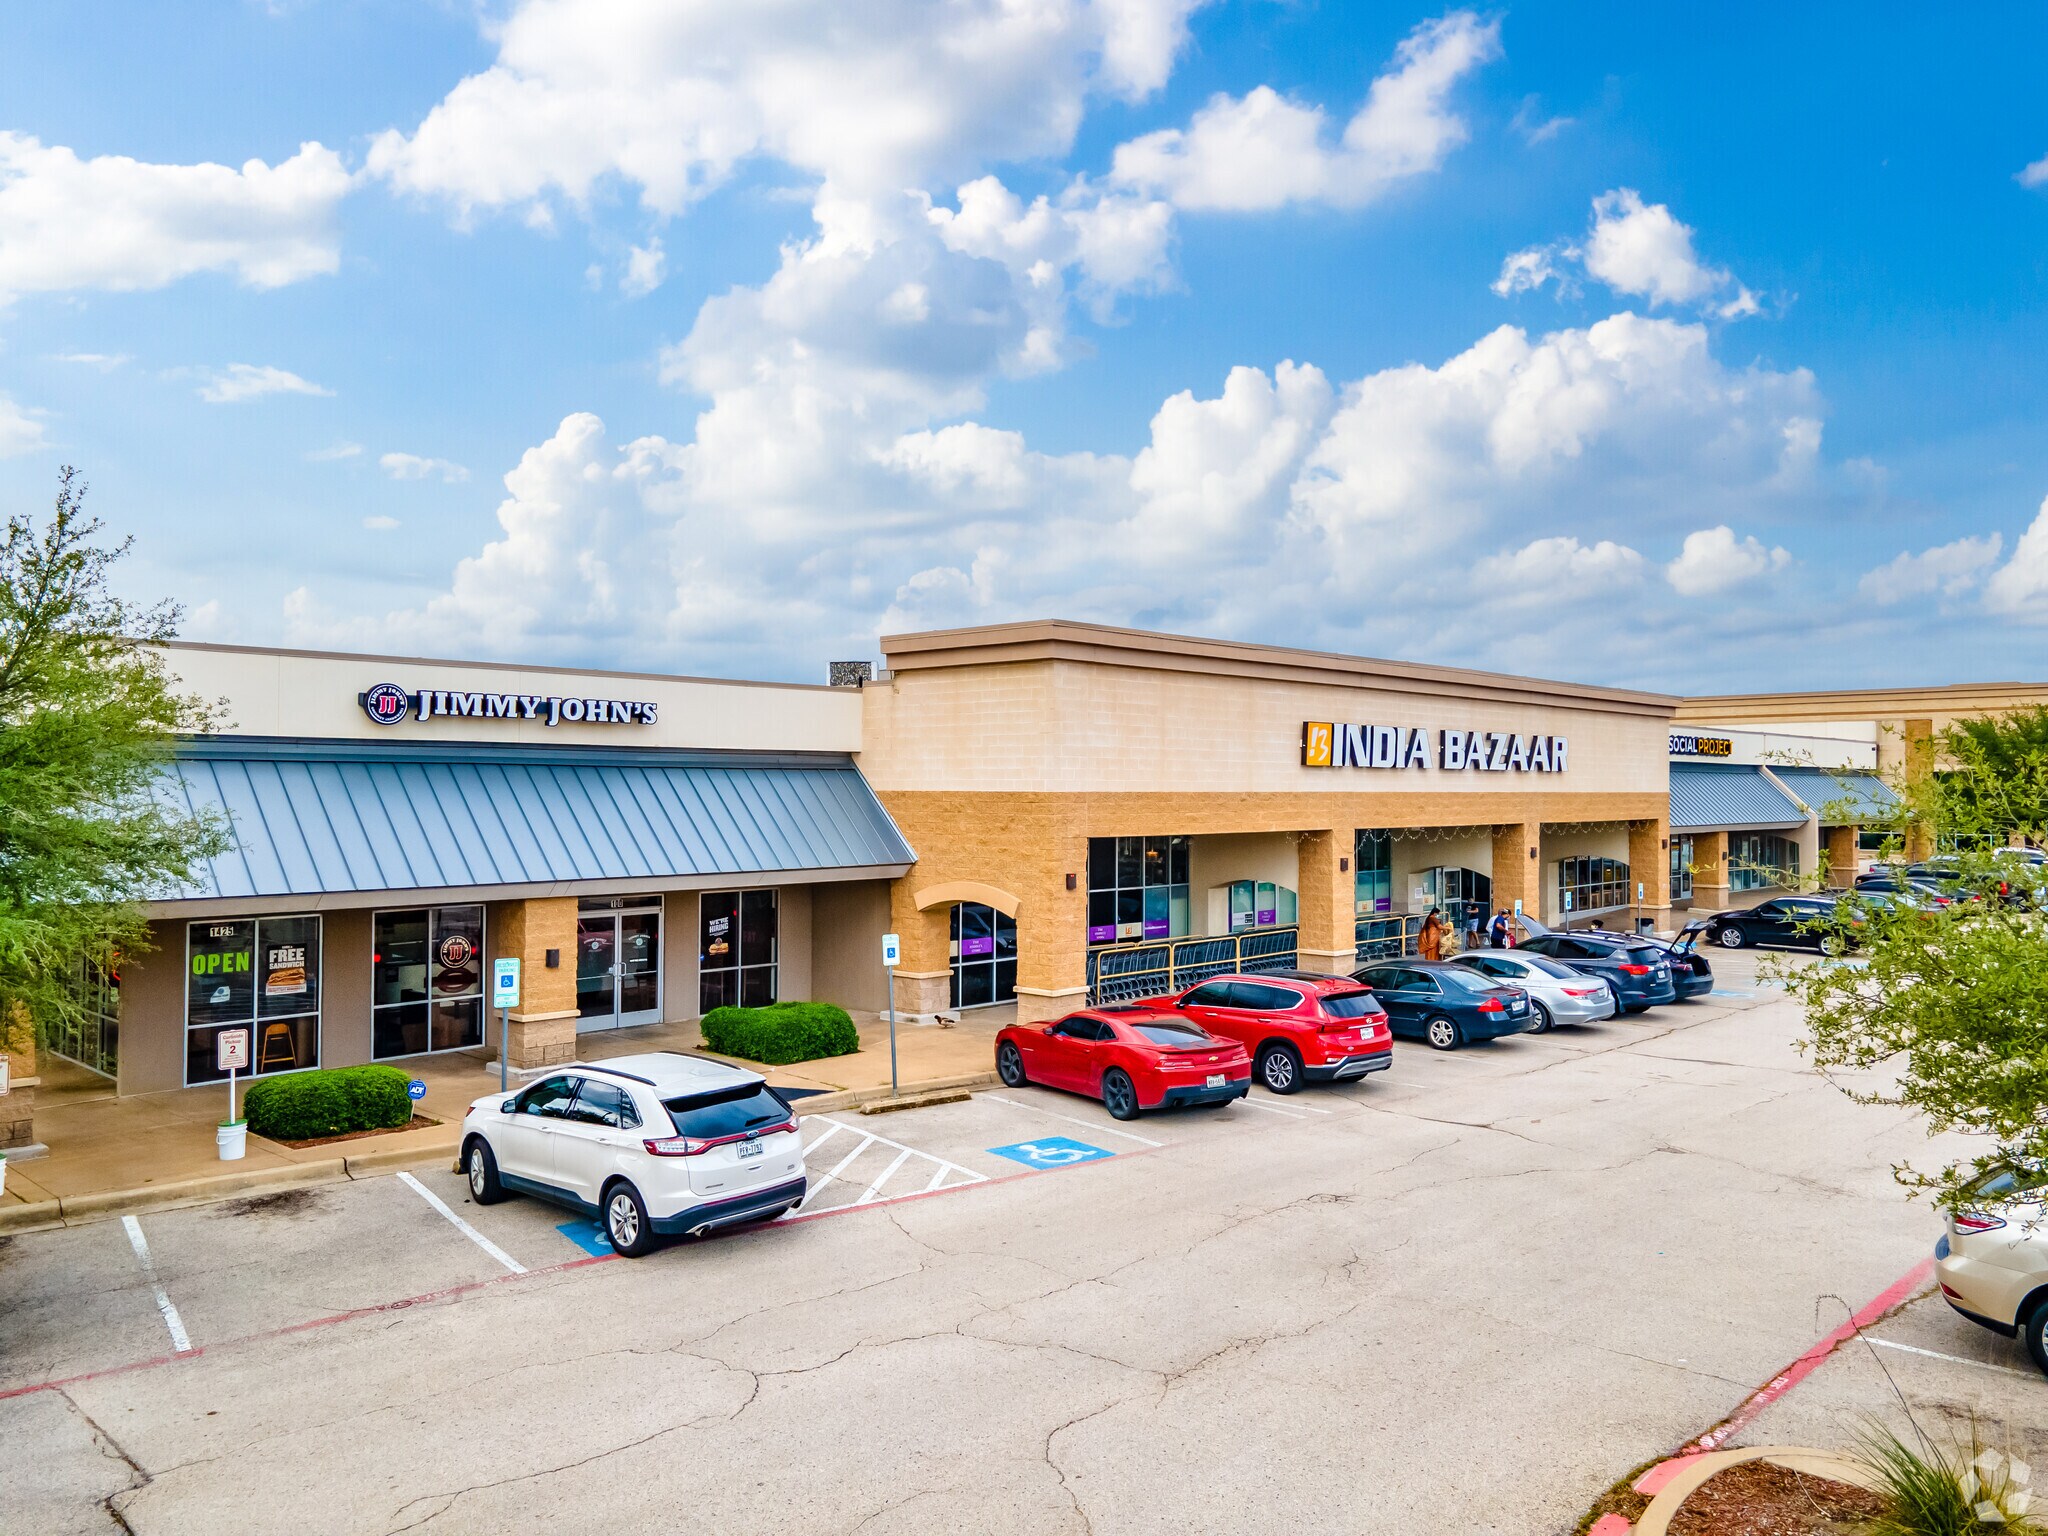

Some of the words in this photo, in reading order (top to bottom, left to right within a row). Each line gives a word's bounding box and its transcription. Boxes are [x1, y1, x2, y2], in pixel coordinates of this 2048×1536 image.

[379, 695, 397, 714] JJ
[415, 690, 541, 721] JIMMY
[545, 697, 658, 726] JOHN'S
[1332, 723, 1433, 769] INDIA
[1440, 729, 1569, 772] BAZAAR
[1669, 736, 1698, 753] SOCIAL
[1698, 738, 1734, 755] PROJECT
[210, 927, 234, 937] 1425
[269, 948, 305, 962] FREE
[449, 944, 463, 960] JJ
[193, 952, 250, 975] OPEN
[269, 961, 305, 970] SANDWICH
[229, 1045, 236, 1054] 2
[410, 1086, 425, 1094] ADT
